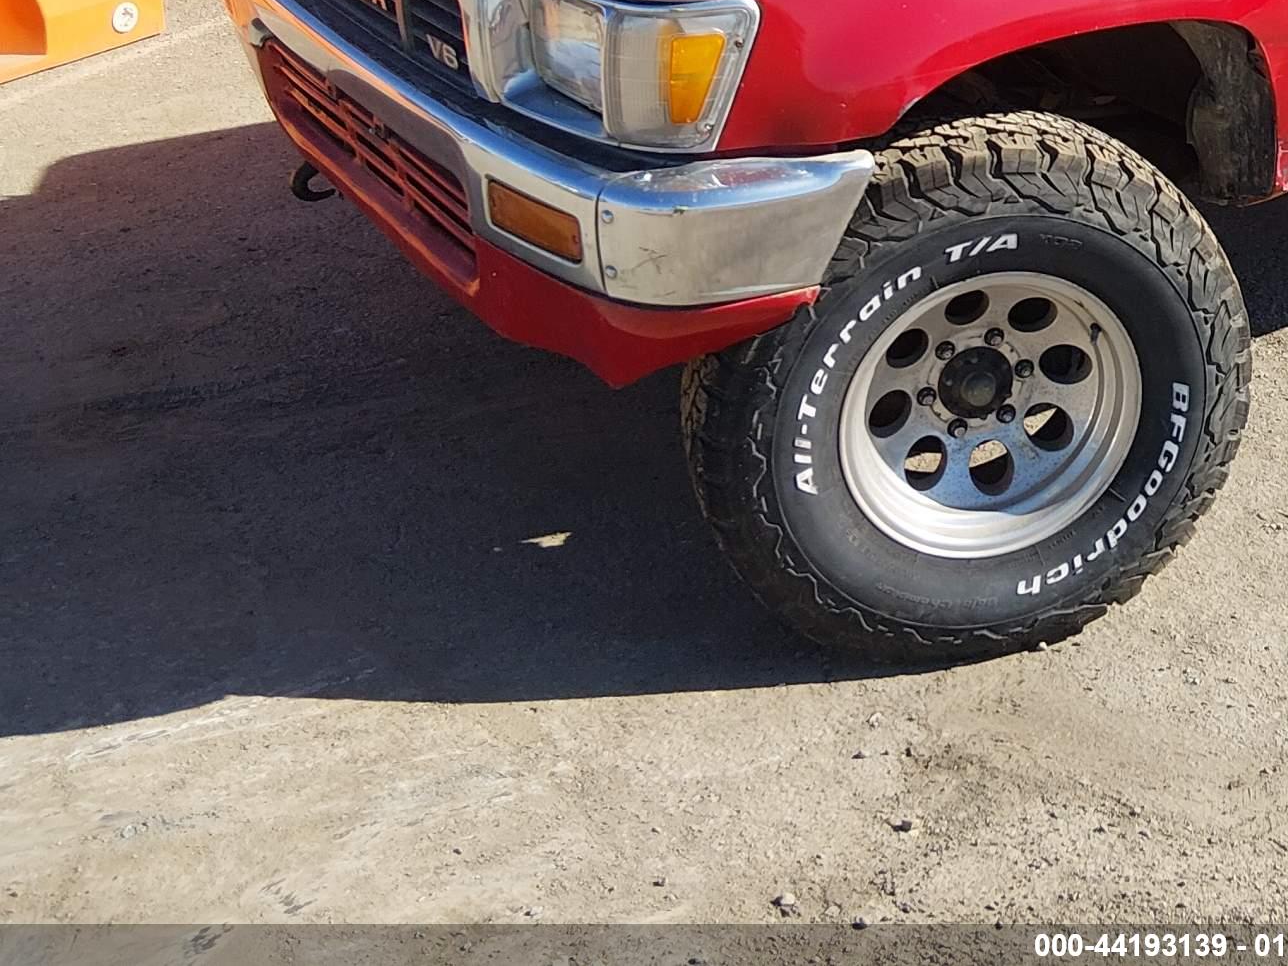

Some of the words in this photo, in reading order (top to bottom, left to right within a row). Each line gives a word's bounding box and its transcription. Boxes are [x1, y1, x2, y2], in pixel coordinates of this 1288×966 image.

[427, 34, 459, 71] V6
[794, 265, 922, 495] All-Terrain
[945, 233, 1018, 264] T/A
[1016, 381, 1190, 596] BFGoodrich
